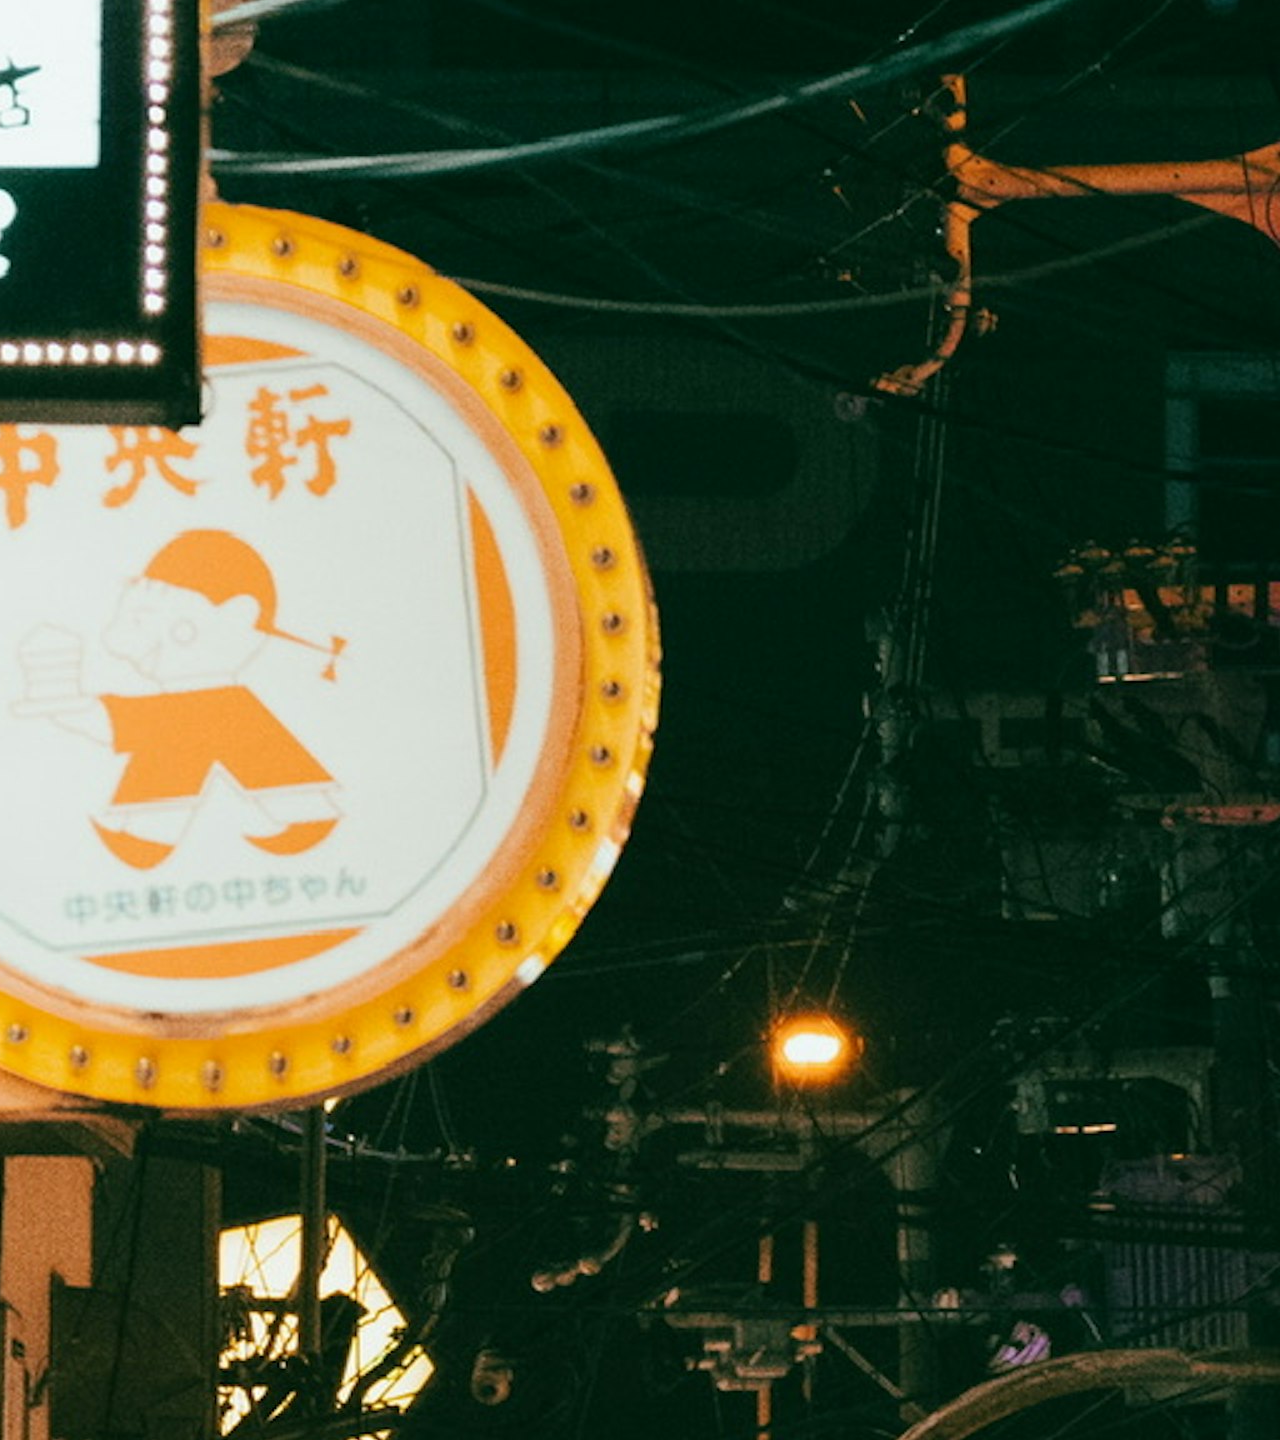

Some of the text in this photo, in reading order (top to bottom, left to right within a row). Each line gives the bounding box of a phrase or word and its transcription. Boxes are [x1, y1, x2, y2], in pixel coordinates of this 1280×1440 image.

[63, 866, 368, 926] 中央軒の中ちゃん
